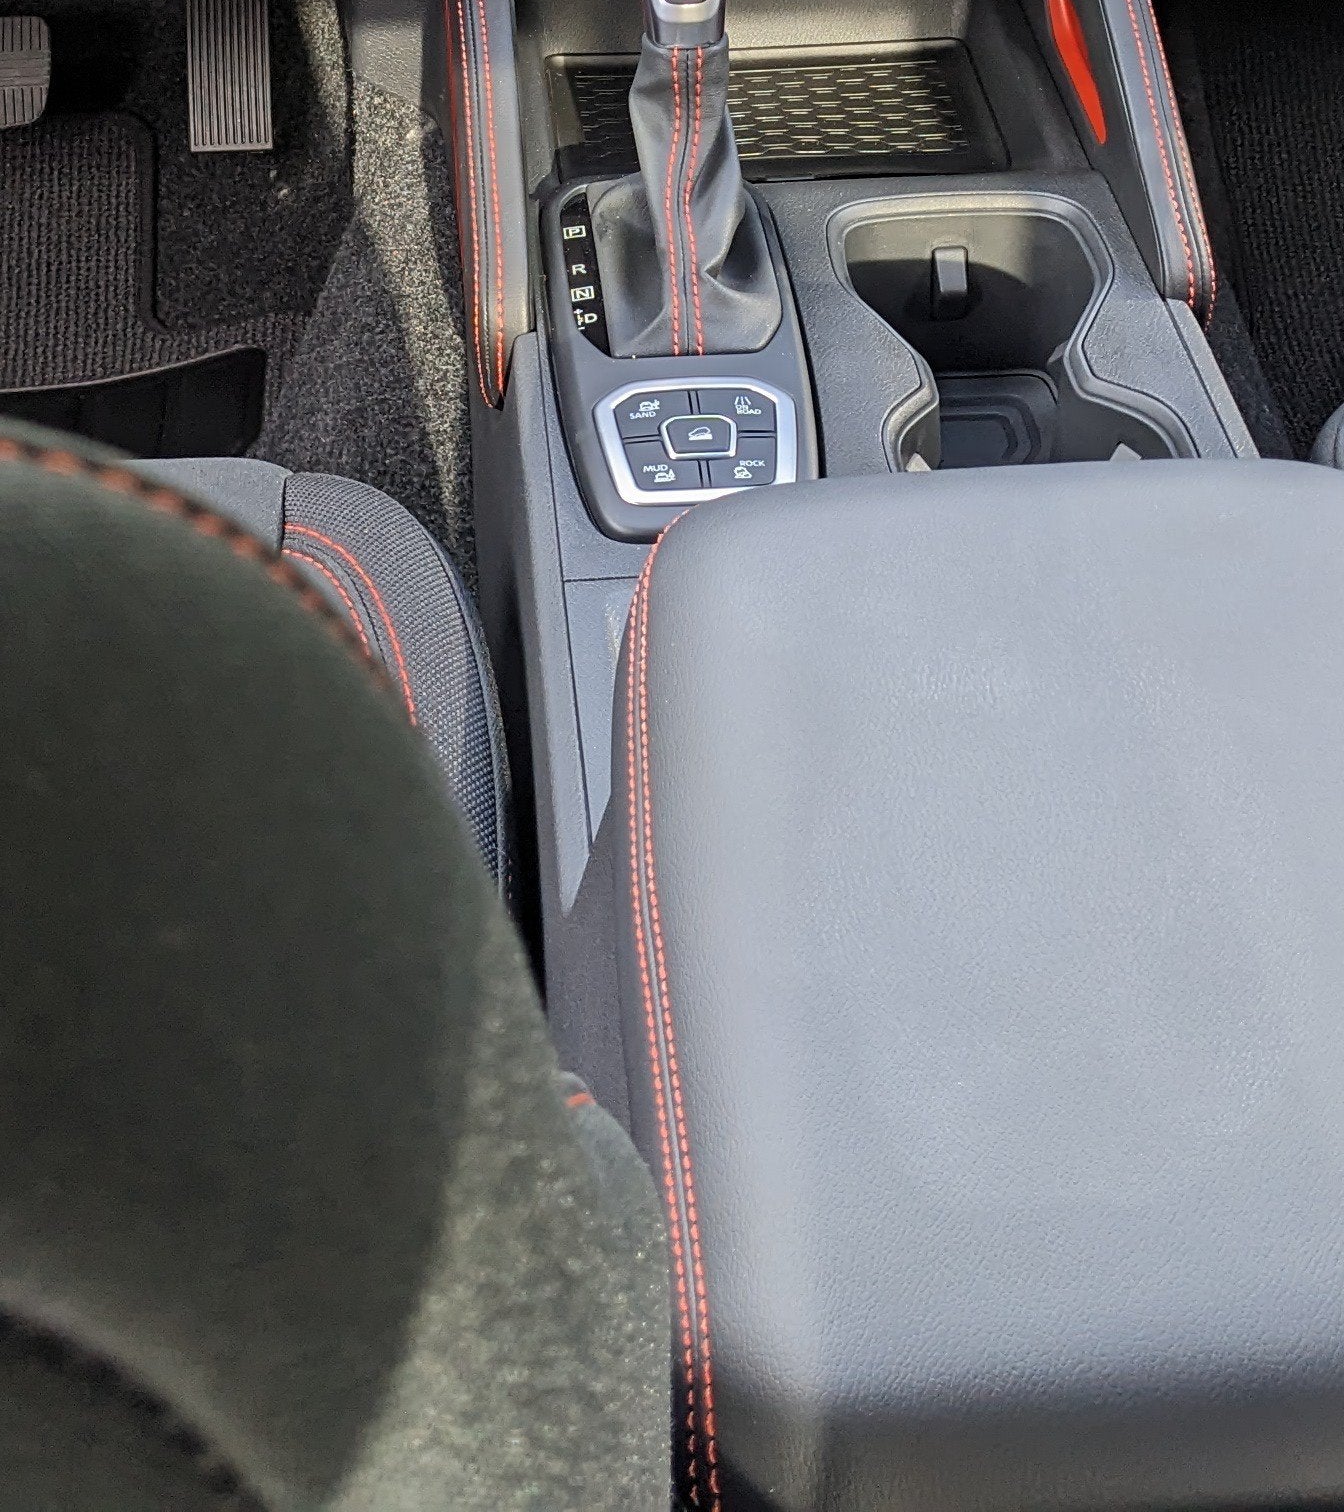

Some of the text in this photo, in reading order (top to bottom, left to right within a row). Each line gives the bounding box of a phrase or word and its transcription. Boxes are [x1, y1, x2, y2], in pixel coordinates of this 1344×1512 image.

[572, 264, 587, 275] R
[584, 313, 598, 324] D
[629, 411, 656, 419] SAND
[643, 464, 668, 473] MUD
